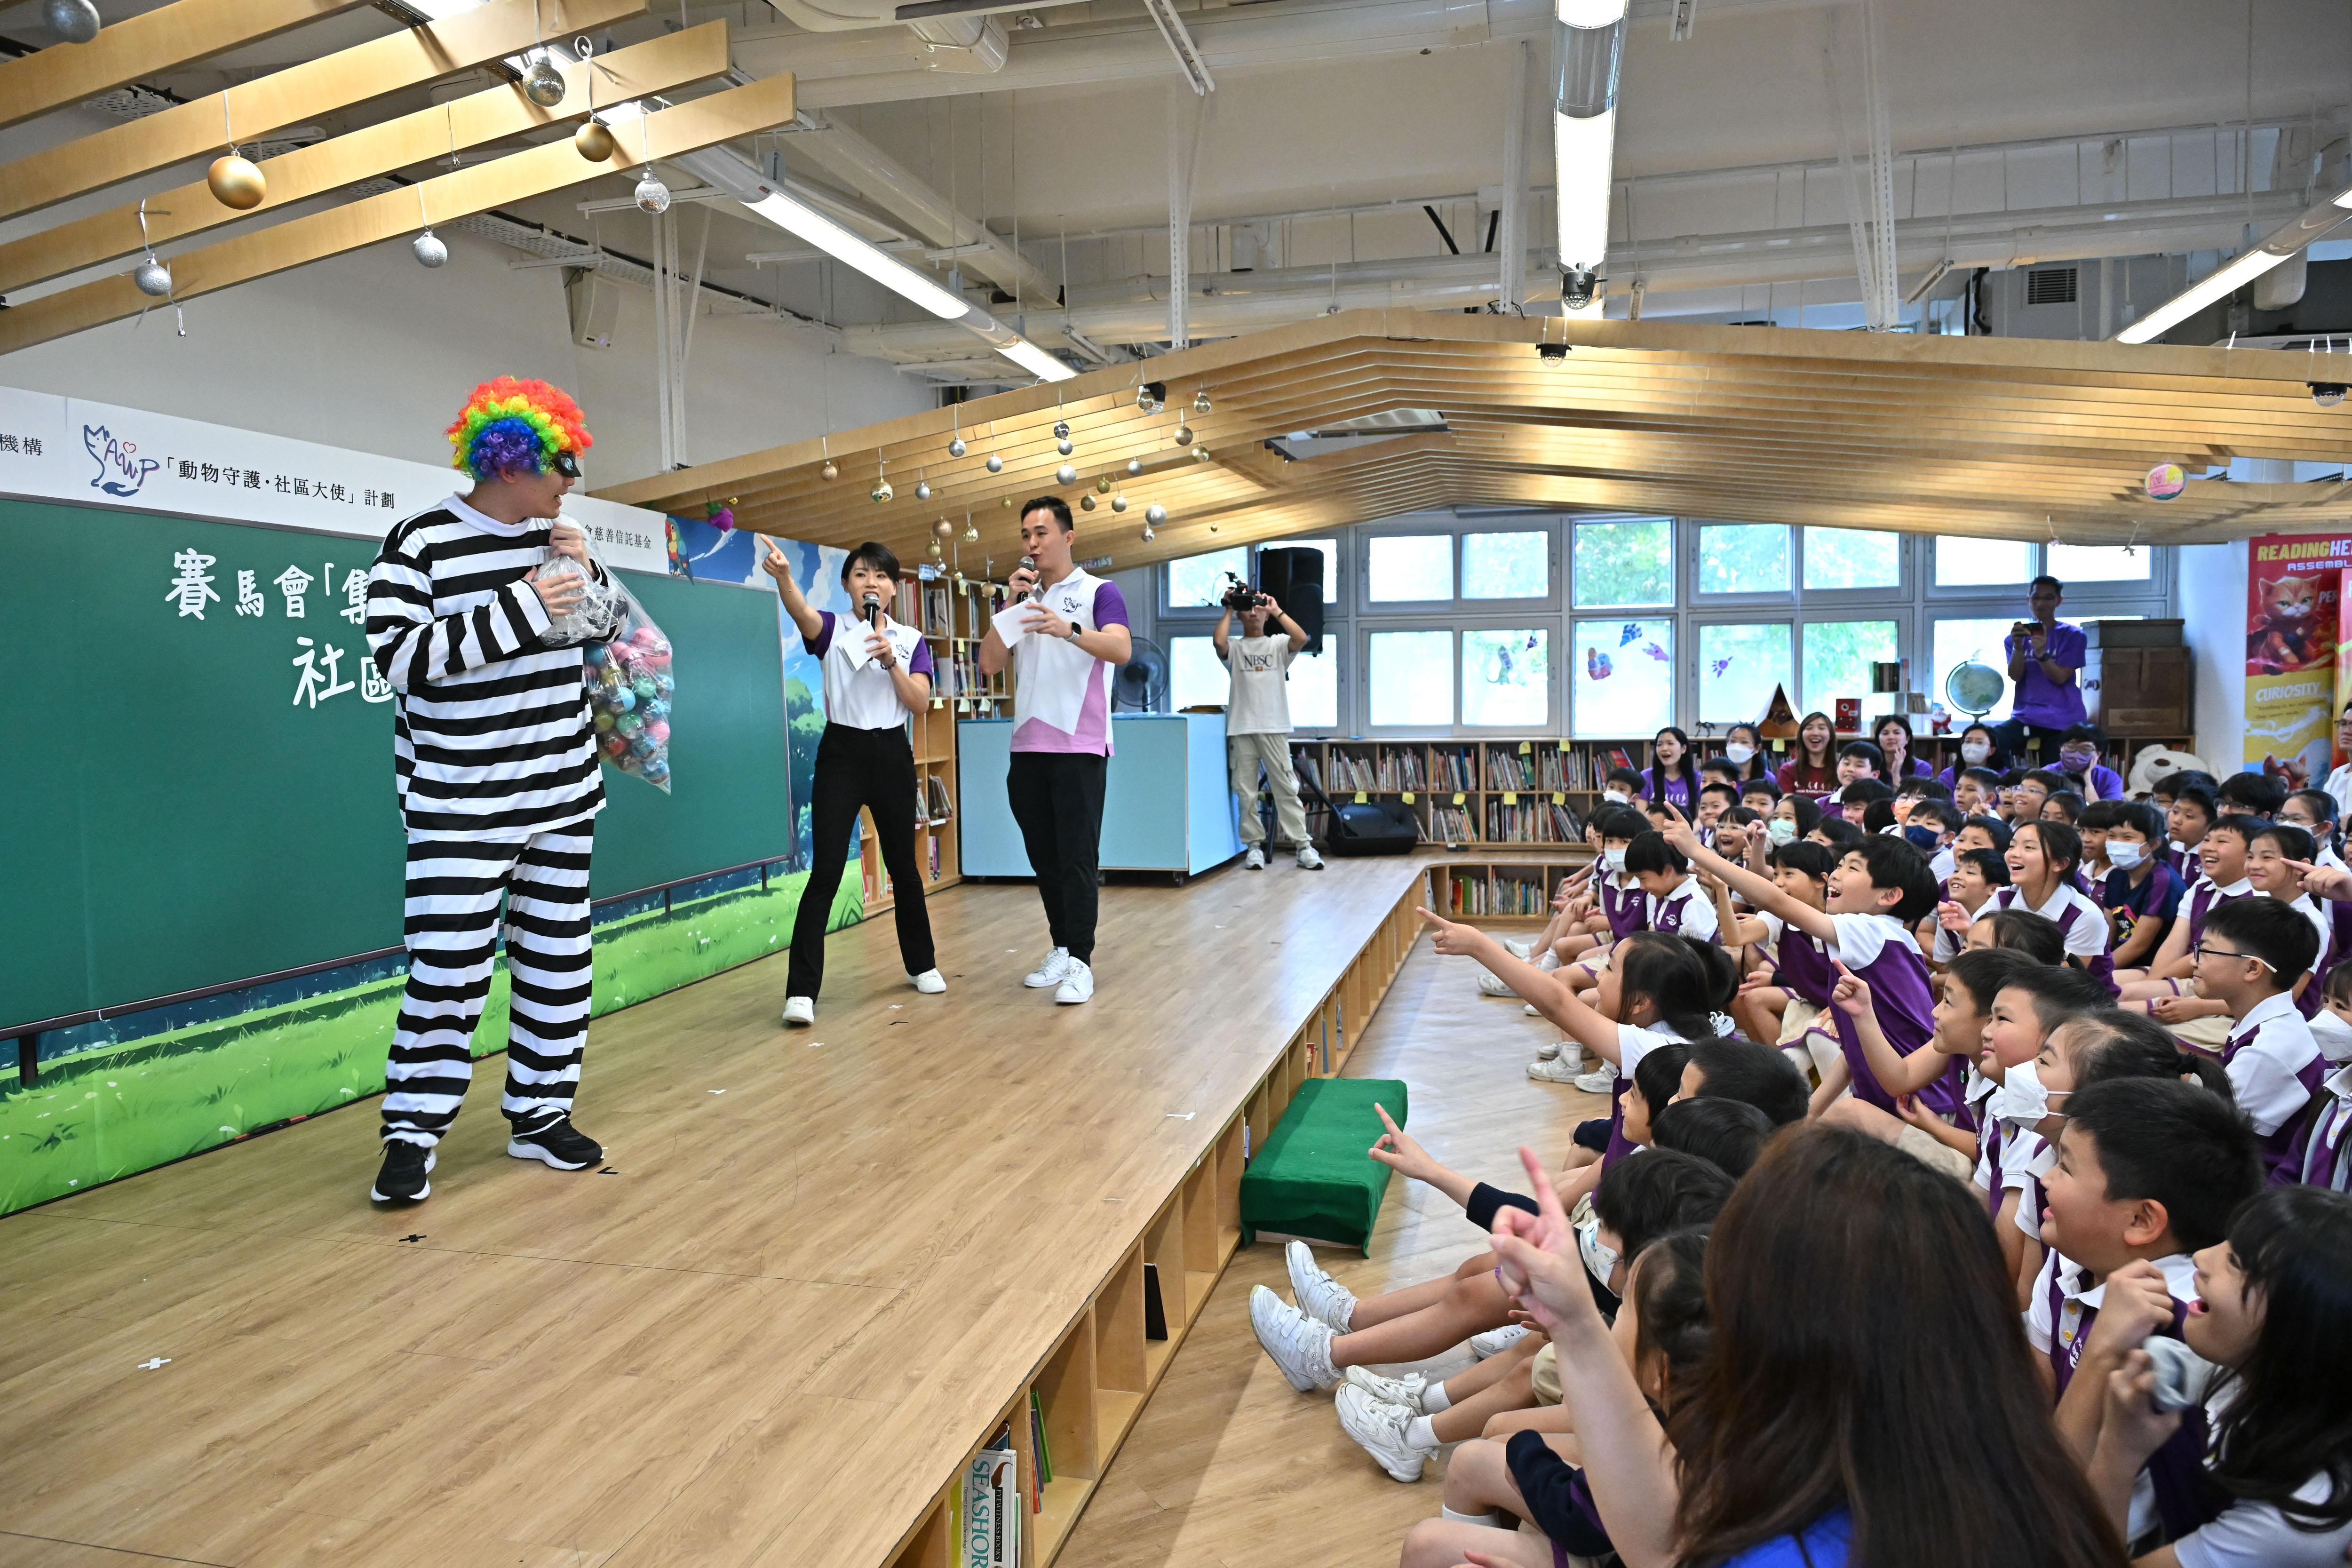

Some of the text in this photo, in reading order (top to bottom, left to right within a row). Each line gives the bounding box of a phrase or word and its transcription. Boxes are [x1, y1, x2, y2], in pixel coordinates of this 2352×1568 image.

[0, 433, 43, 456] 機構
[1243, 654, 1272, 668] NBSC
[2256, 682, 2320, 702] CURIOSITY
